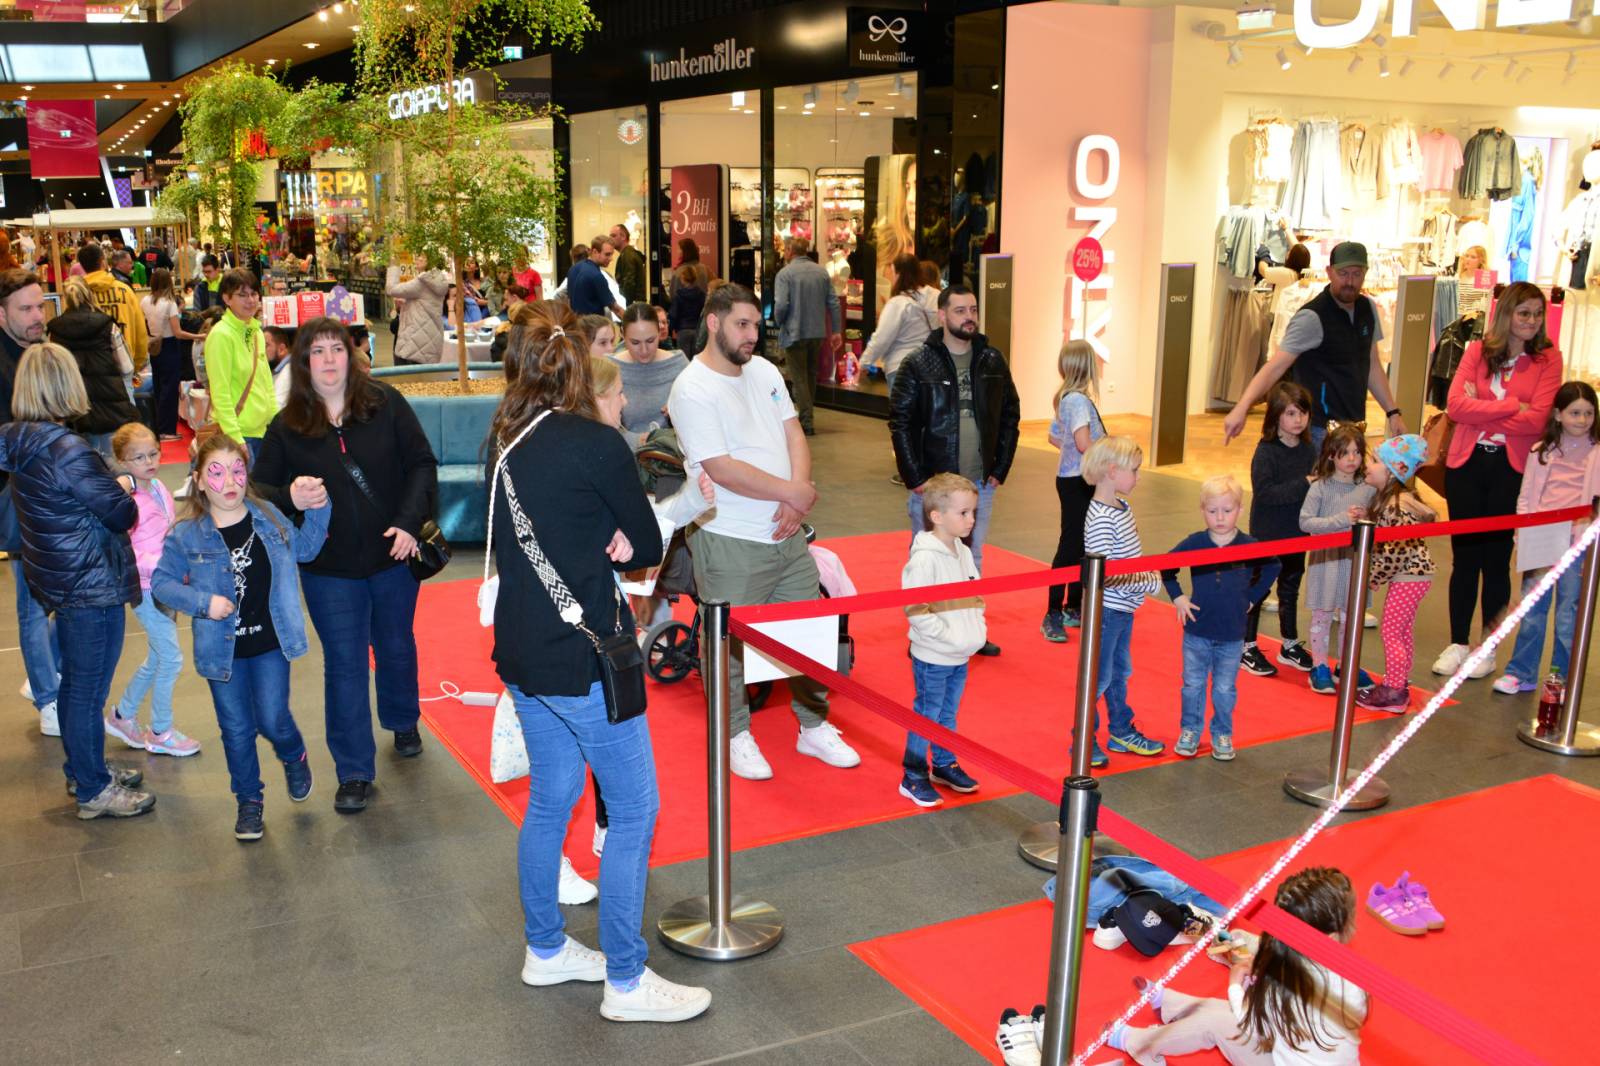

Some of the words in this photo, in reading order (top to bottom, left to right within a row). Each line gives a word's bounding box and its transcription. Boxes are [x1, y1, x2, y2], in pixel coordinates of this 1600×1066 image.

[650, 38, 755, 82] hunkemöller
[859, 49, 915, 63] hunkemöller
[692, 198, 711, 216] BH
[691, 218, 716, 235] gratis
[1076, 249, 1100, 269] 25%
[95, 287, 127, 305] UILT
[1170, 295, 1187, 303] ONLY
[1407, 312, 1425, 321] ONLY
